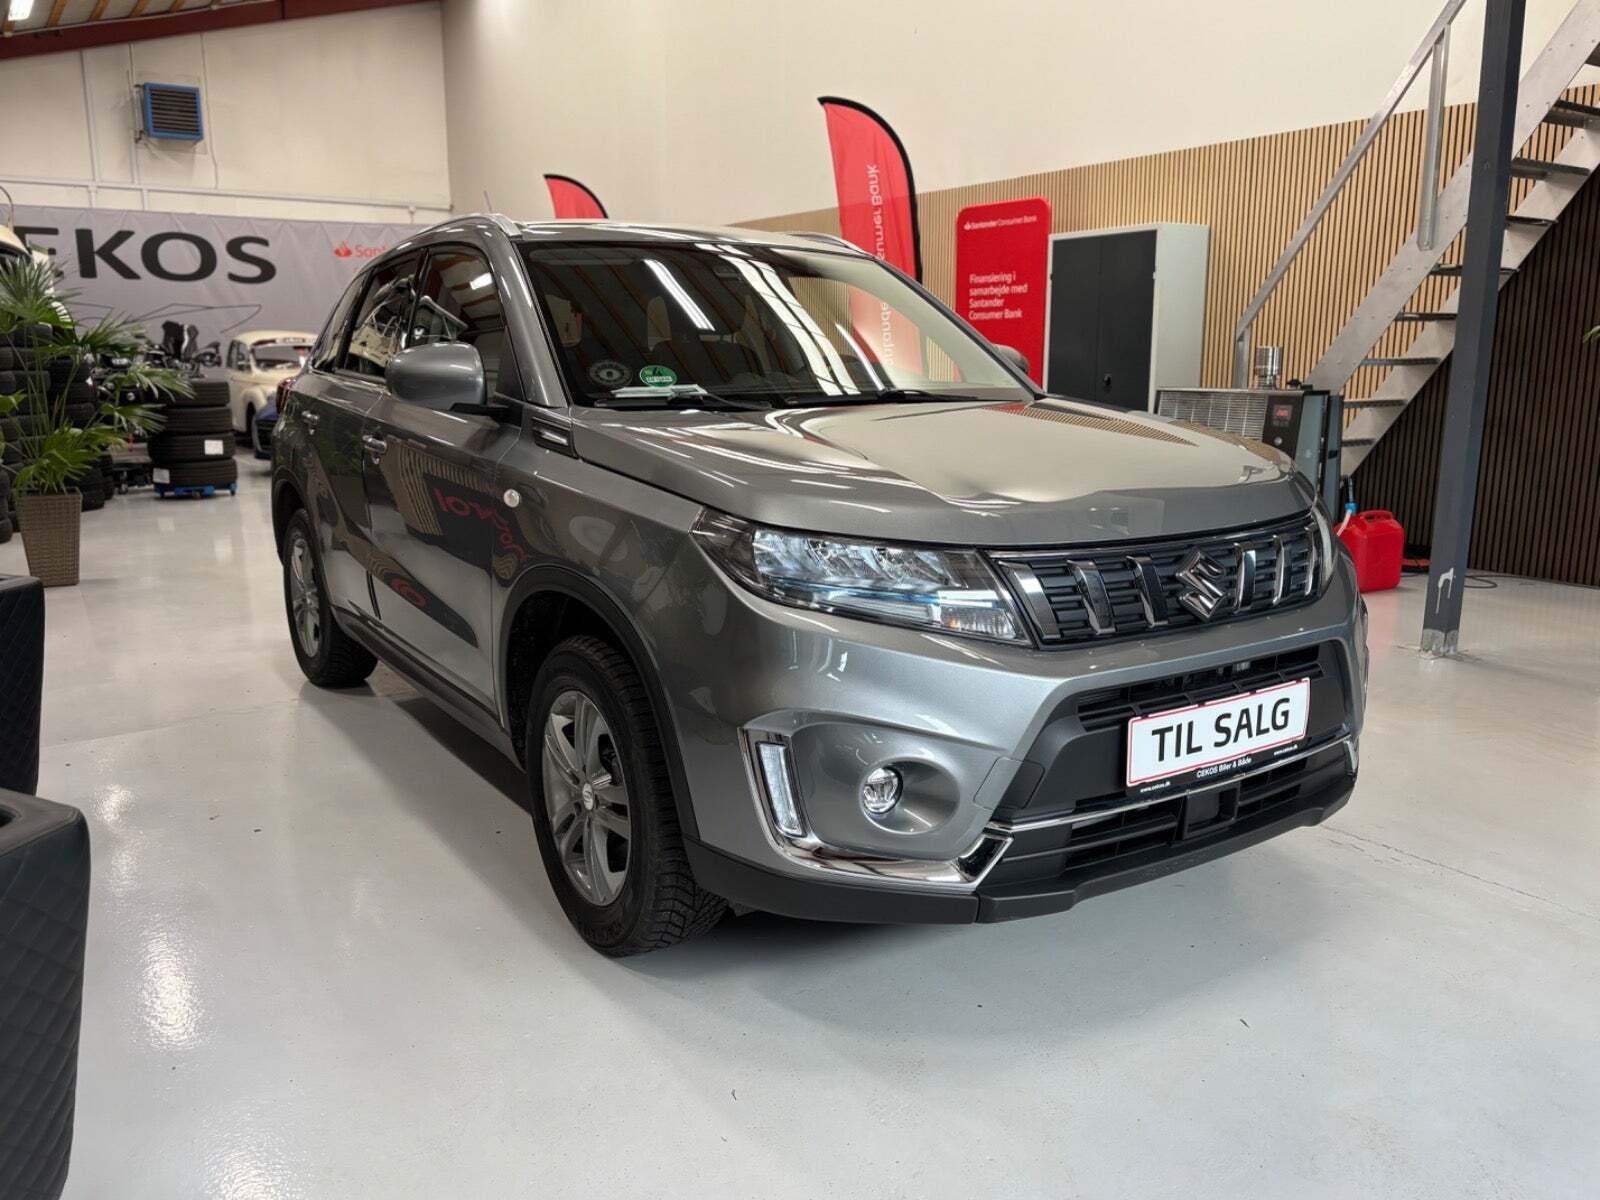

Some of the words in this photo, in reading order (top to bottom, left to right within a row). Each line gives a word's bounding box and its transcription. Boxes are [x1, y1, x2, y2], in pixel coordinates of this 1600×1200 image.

[355, 244, 388, 257] San
[970, 272, 1012, 284] Finansiering
[970, 285, 1009, 297] samarbejde
[1011, 283, 1028, 293] med
[969, 297, 1004, 308] Santander
[969, 310, 1003, 320] Consumer
[1004, 308, 1022, 319] Bank
[1152, 720, 1202, 761] TIL
[1214, 698, 1290, 748] SALG
